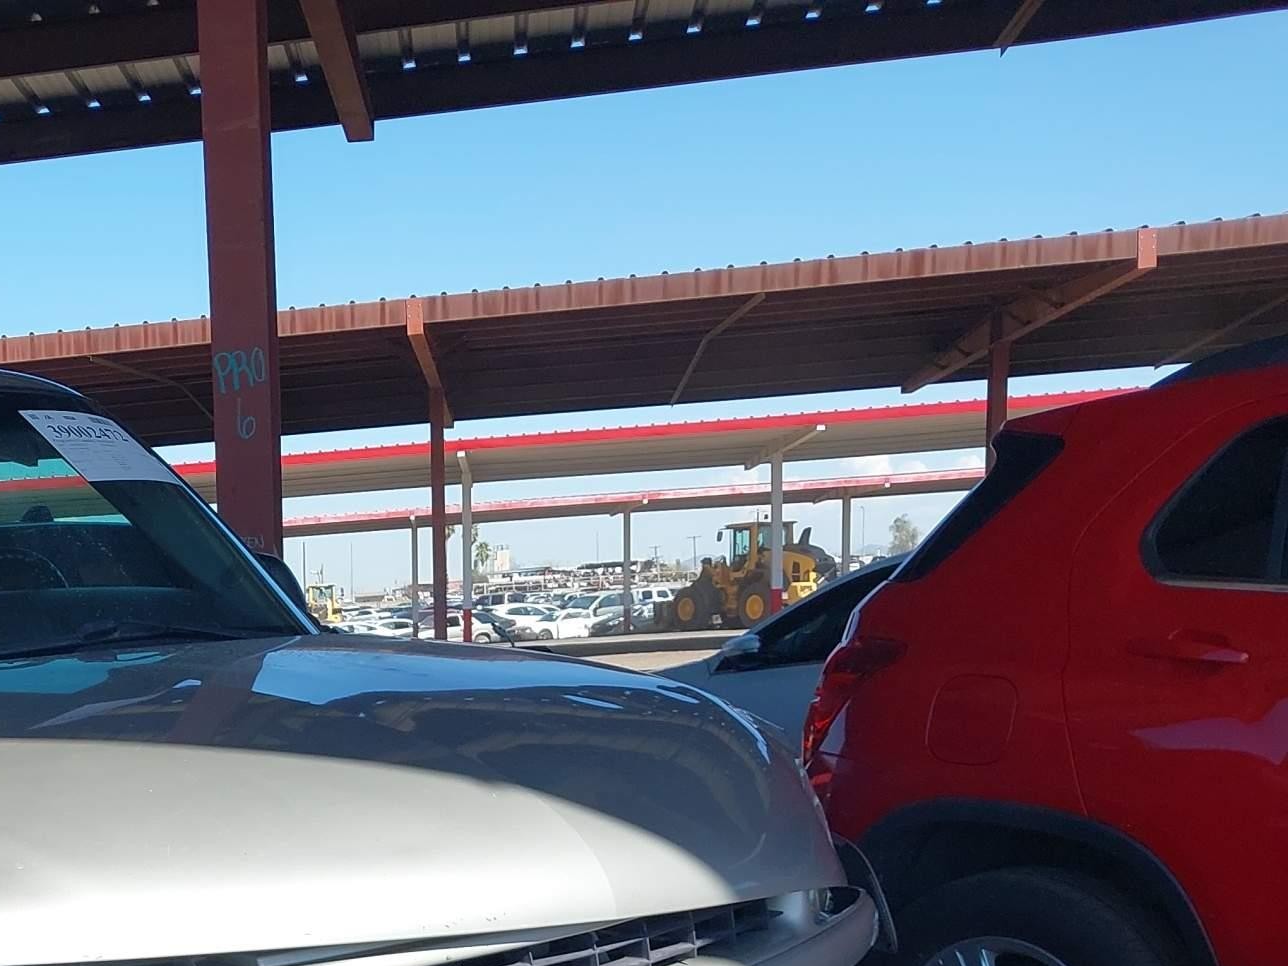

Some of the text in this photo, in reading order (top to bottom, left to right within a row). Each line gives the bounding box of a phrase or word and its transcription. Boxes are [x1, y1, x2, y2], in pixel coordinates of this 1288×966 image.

[214, 346, 266, 395] PRO
[46, 424, 130, 443] 39002472
[237, 397, 258, 440] 6
